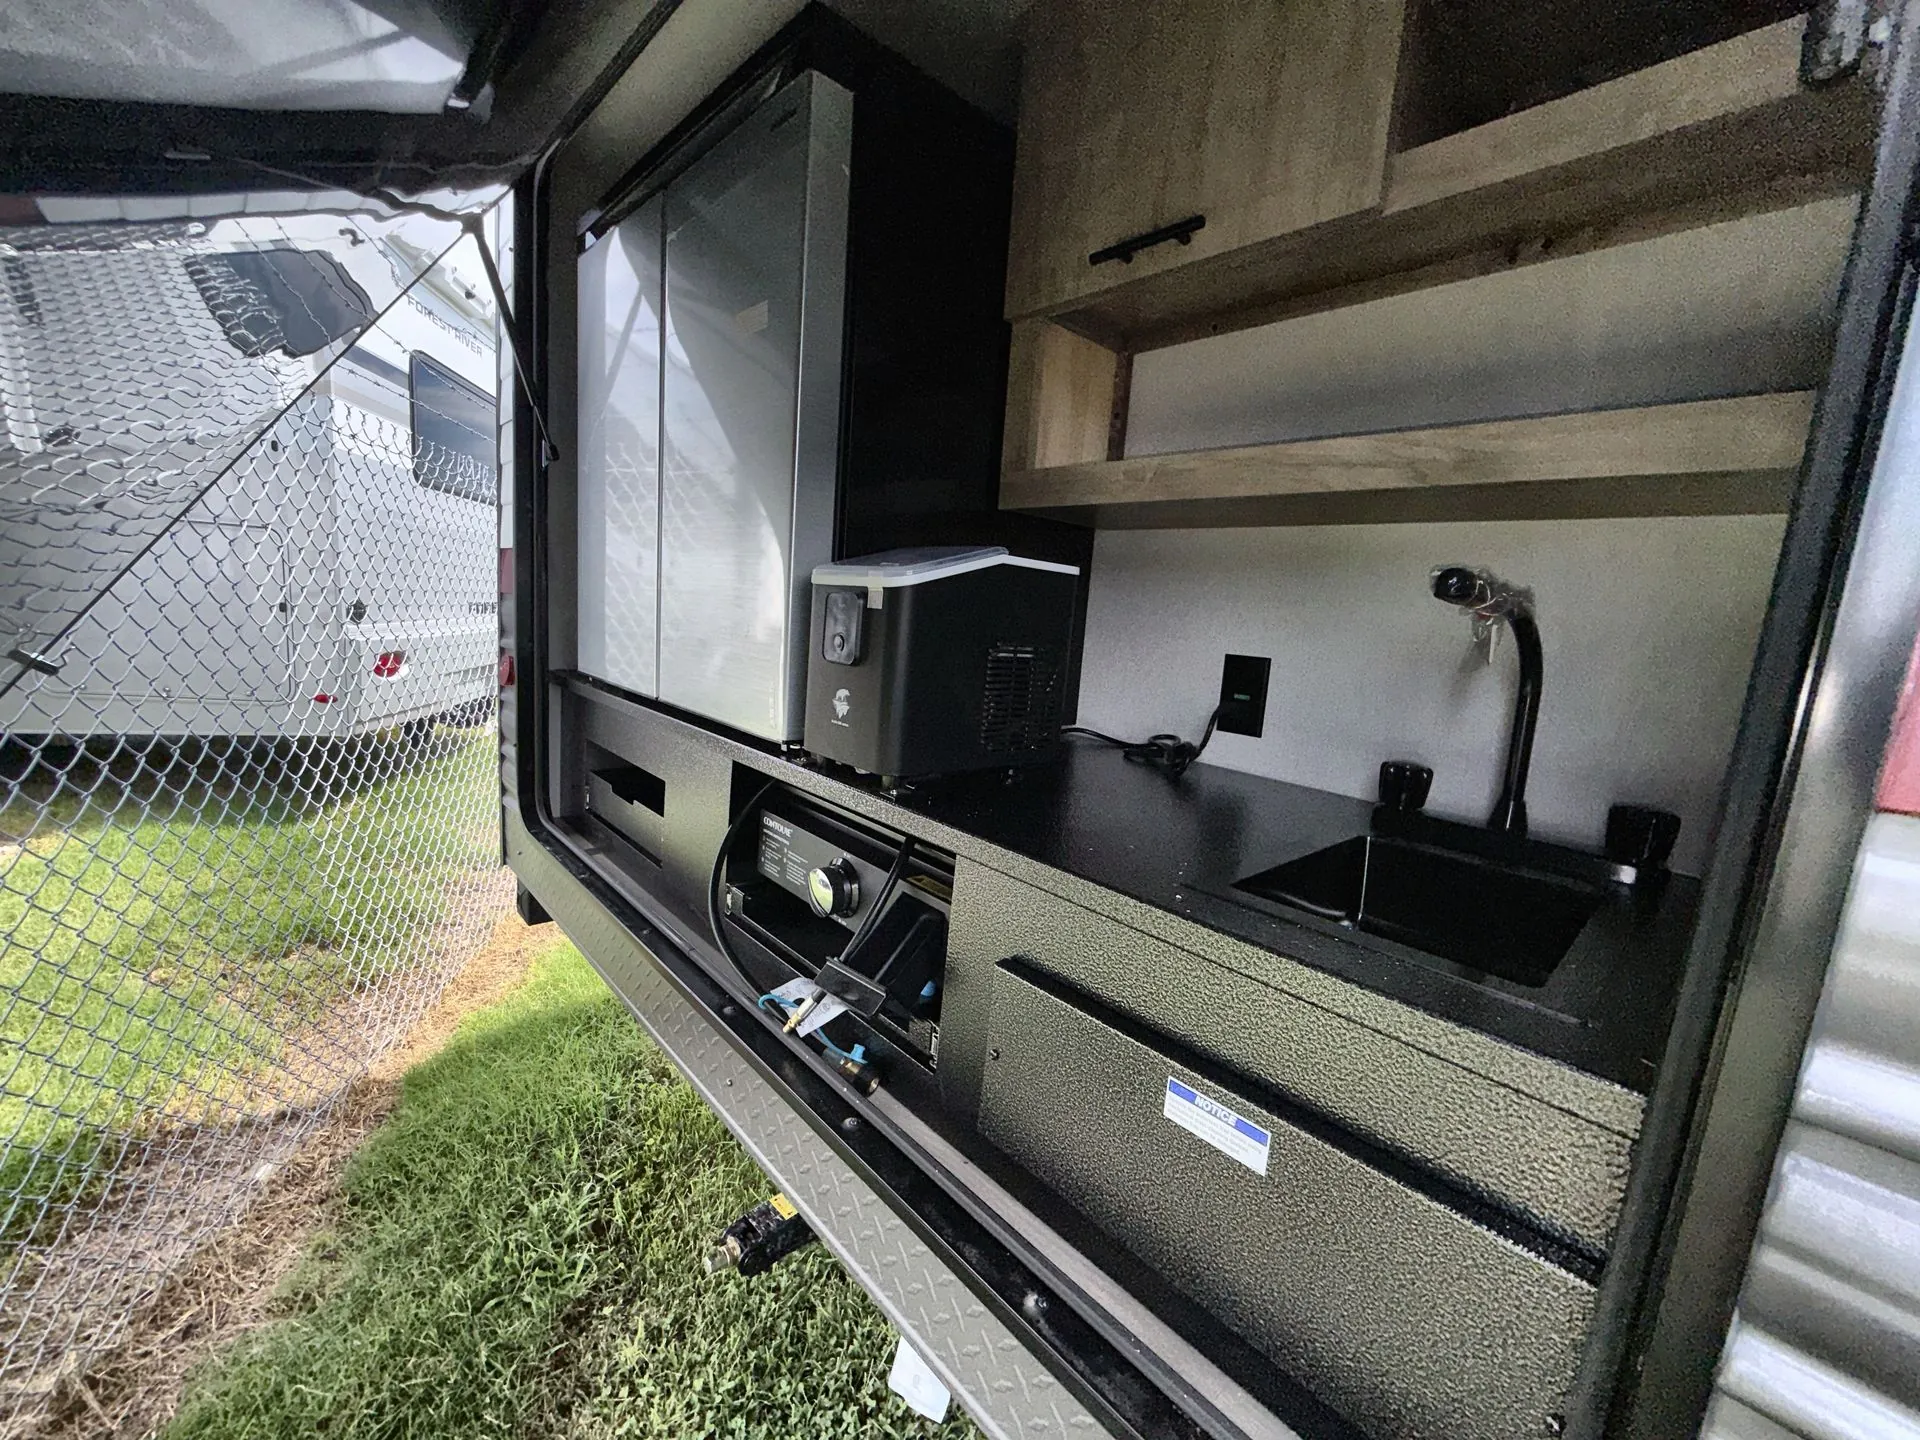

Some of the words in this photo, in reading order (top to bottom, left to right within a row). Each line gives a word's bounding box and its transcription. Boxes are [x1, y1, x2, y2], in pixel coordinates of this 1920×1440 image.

[408, 297, 453, 334] FOREST
[454, 330, 483, 357] RIVER
[1194, 1096, 1238, 1127] NOTICE
